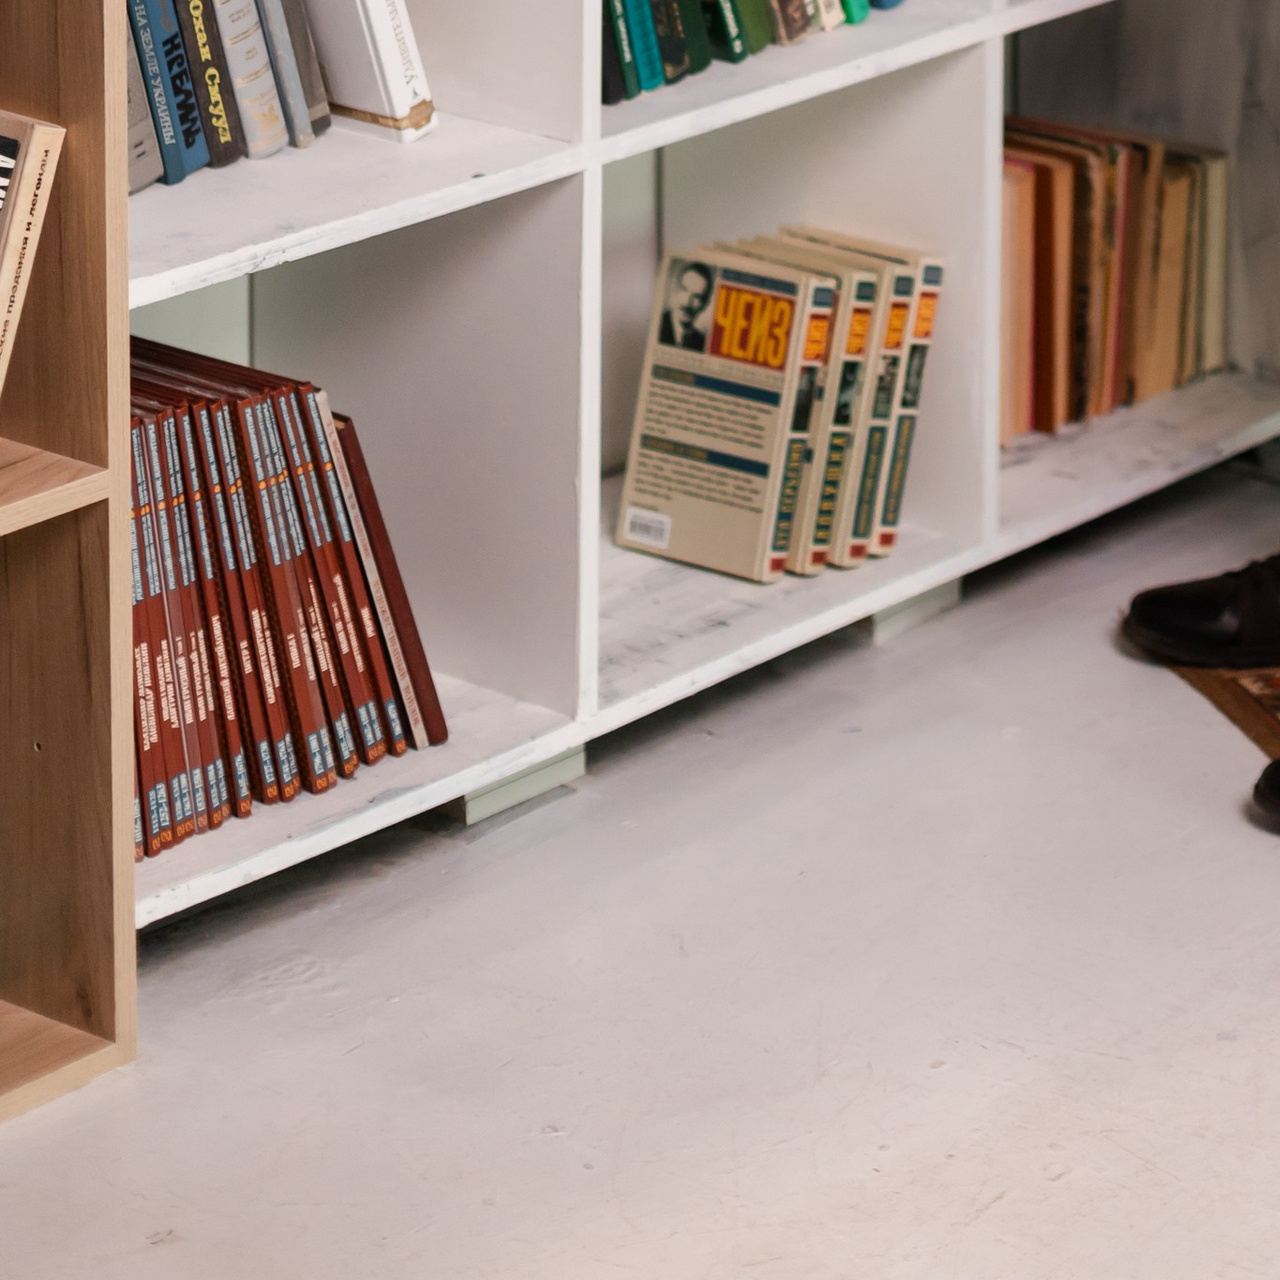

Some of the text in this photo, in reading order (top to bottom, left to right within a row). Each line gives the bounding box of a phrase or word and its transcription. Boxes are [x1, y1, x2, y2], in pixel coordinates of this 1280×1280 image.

[134, 4, 147, 22] НА
[139, 27, 159, 75] ЗЕМЛЕ
[149, 76, 175, 144] УКРАИНЫ
[200, 65, 236, 144] Смуул
[26, 221, 33, 233] и
